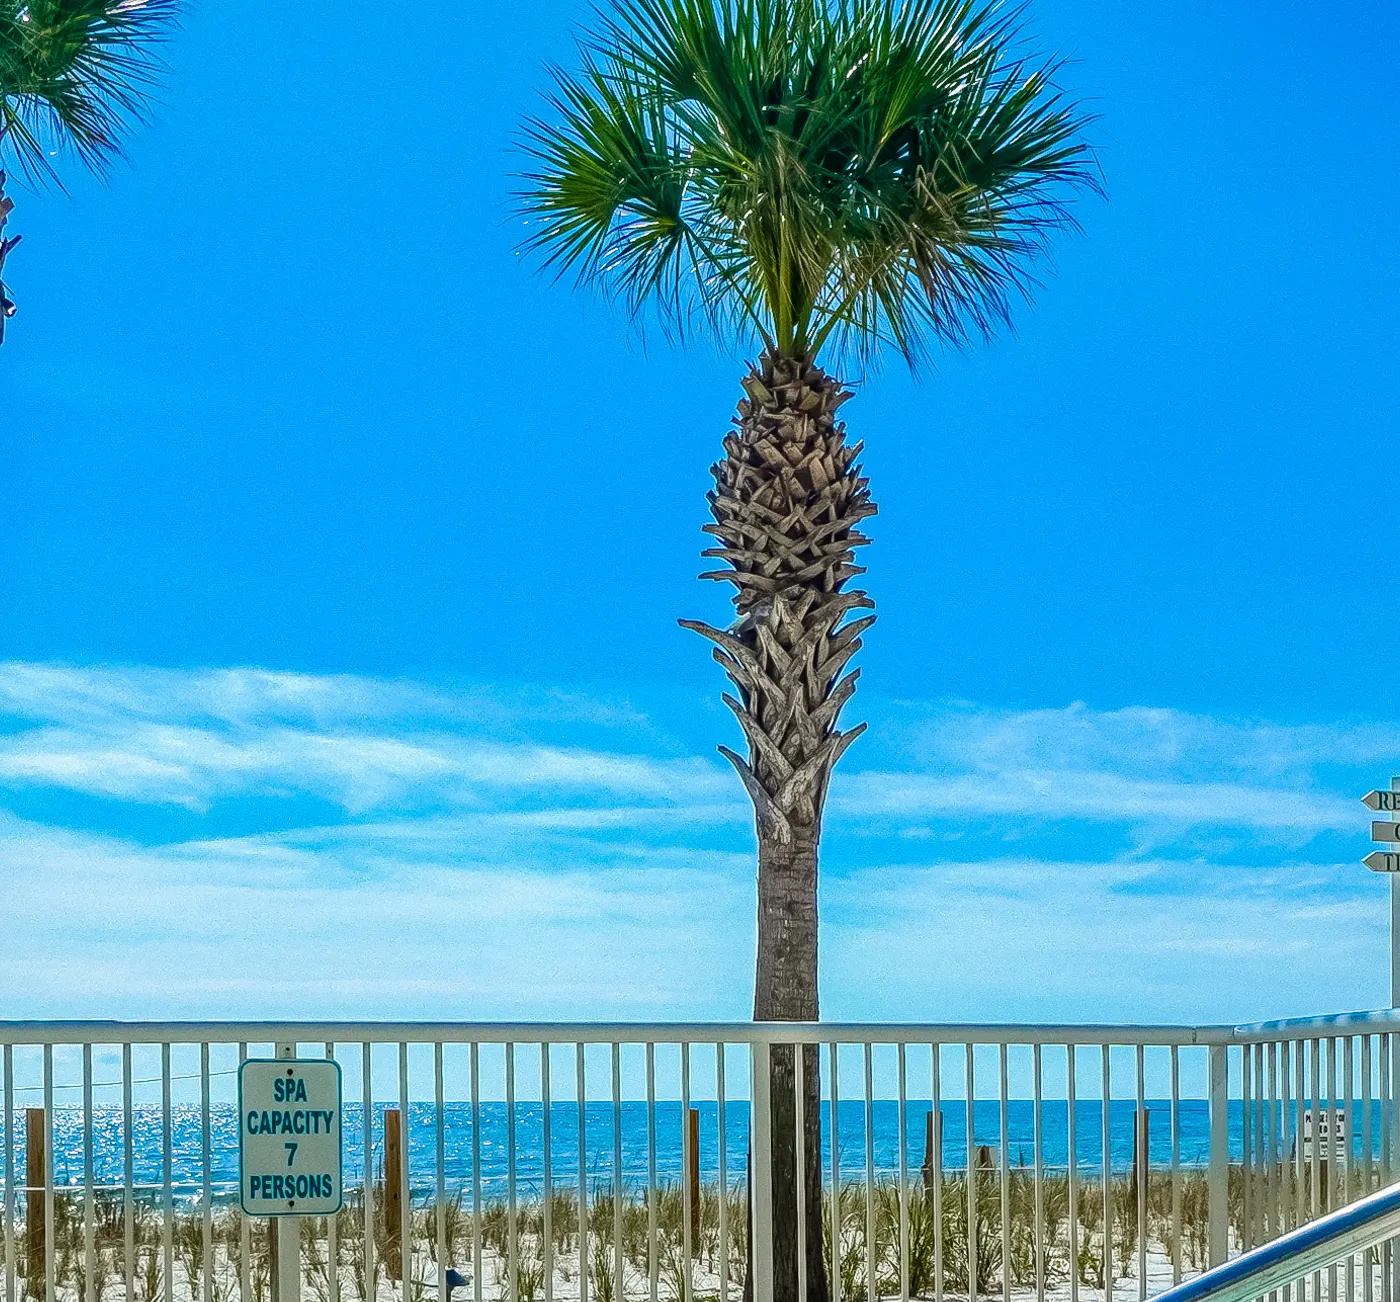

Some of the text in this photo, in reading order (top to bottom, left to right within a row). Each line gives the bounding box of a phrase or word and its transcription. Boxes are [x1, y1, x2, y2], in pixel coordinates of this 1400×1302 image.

[273, 1078, 307, 1102] SPA
[247, 1110, 334, 1135] CAPACITY
[284, 1142, 298, 1166] 7
[250, 1173, 333, 1199] PERSONS
